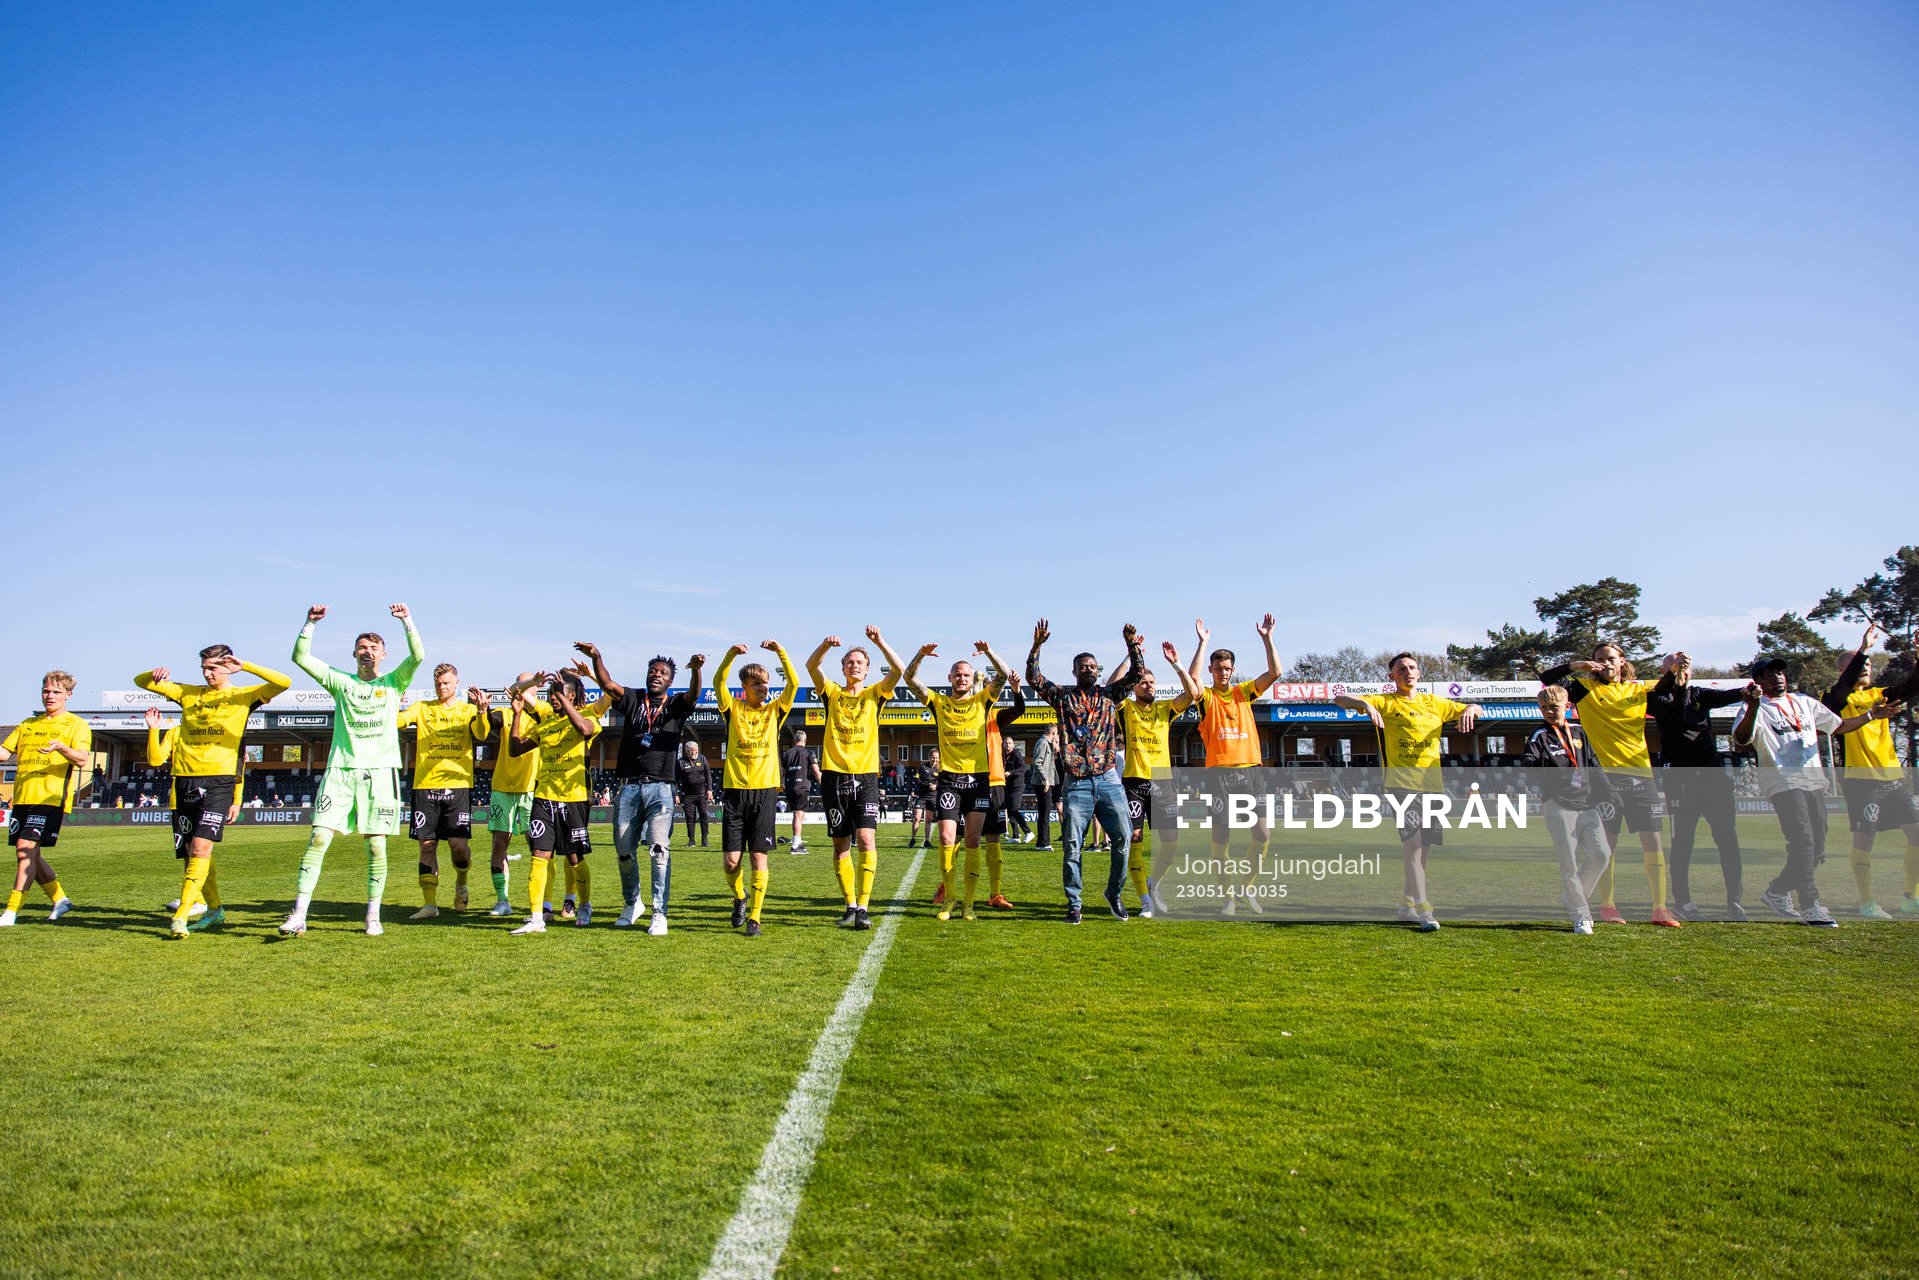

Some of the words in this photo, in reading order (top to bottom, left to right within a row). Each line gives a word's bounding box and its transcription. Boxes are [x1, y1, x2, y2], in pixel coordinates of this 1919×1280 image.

[1277, 684, 1326, 699] SAVE
[1466, 685, 1490, 694] Grant
[1490, 685, 1527, 694] Thornton
[279, 716, 293, 725] XL
[1738, 800, 1776, 812] UNIBE
[131, 811, 172, 823] UNIBE
[255, 811, 302, 822] UNIBET
